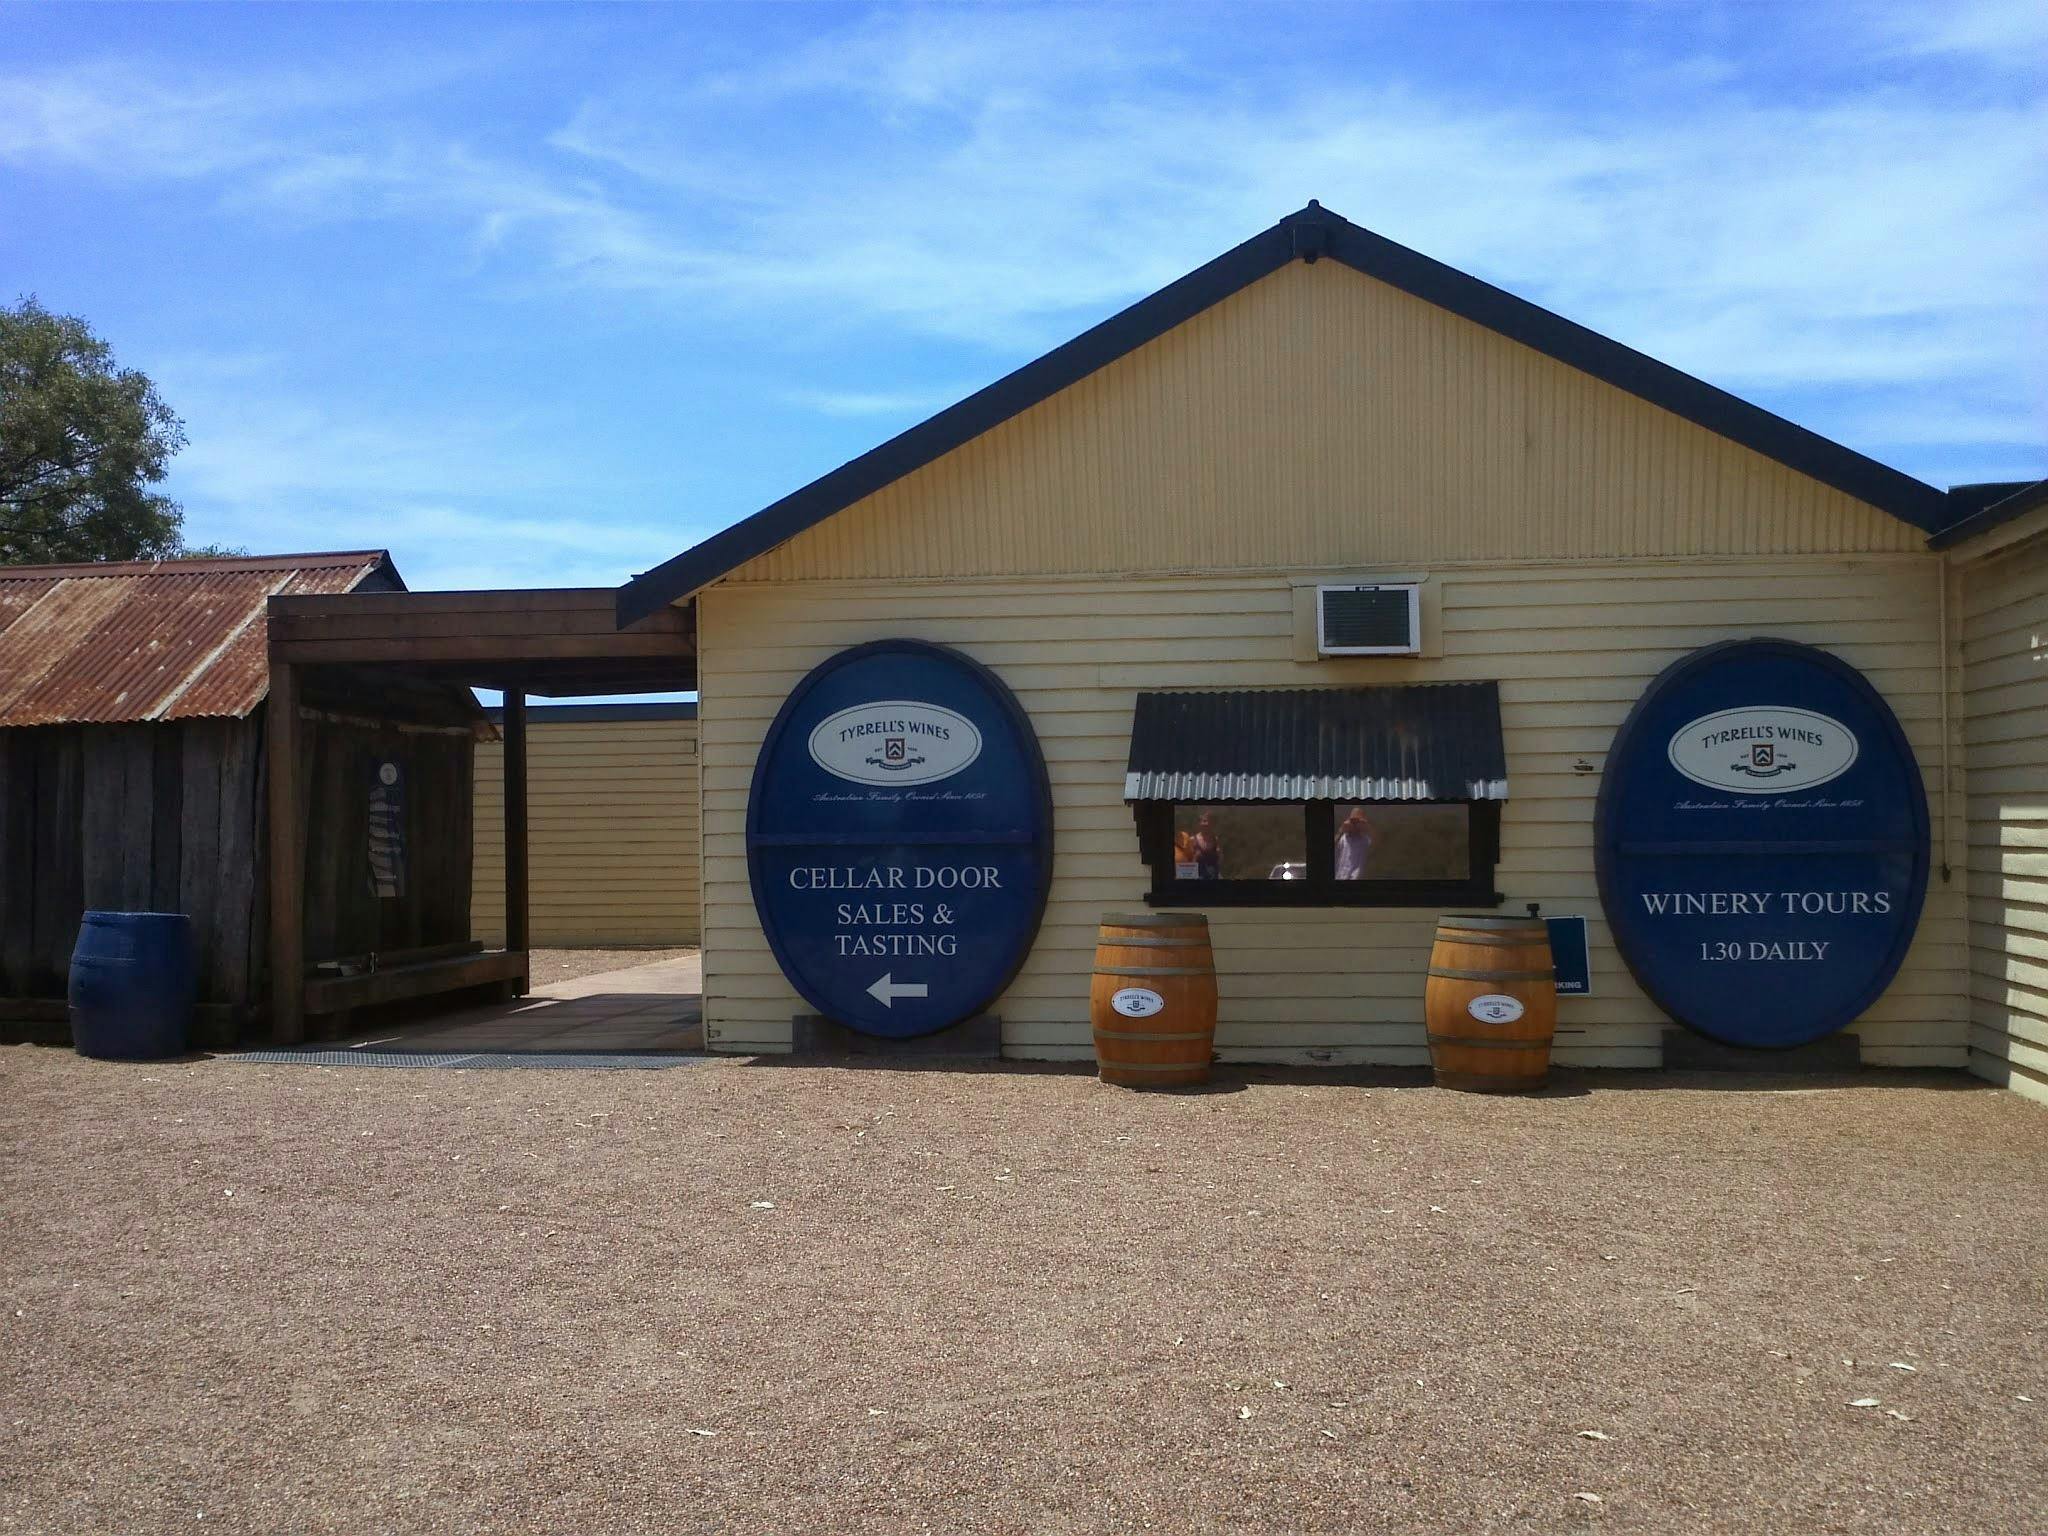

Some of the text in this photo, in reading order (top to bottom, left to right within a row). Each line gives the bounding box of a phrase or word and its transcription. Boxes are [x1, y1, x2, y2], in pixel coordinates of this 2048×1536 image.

[838, 720, 951, 742] TYRRELL'S WINES
[1701, 726, 1823, 749] TYRRELL'S WINES
[789, 866, 1003, 890] CELLAR DOOR
[837, 903, 955, 925] SALES &
[1640, 891, 1891, 915] WINERY TOURS
[834, 935, 958, 956] TASTING
[1699, 941, 1830, 961] 1.30 DAILY
